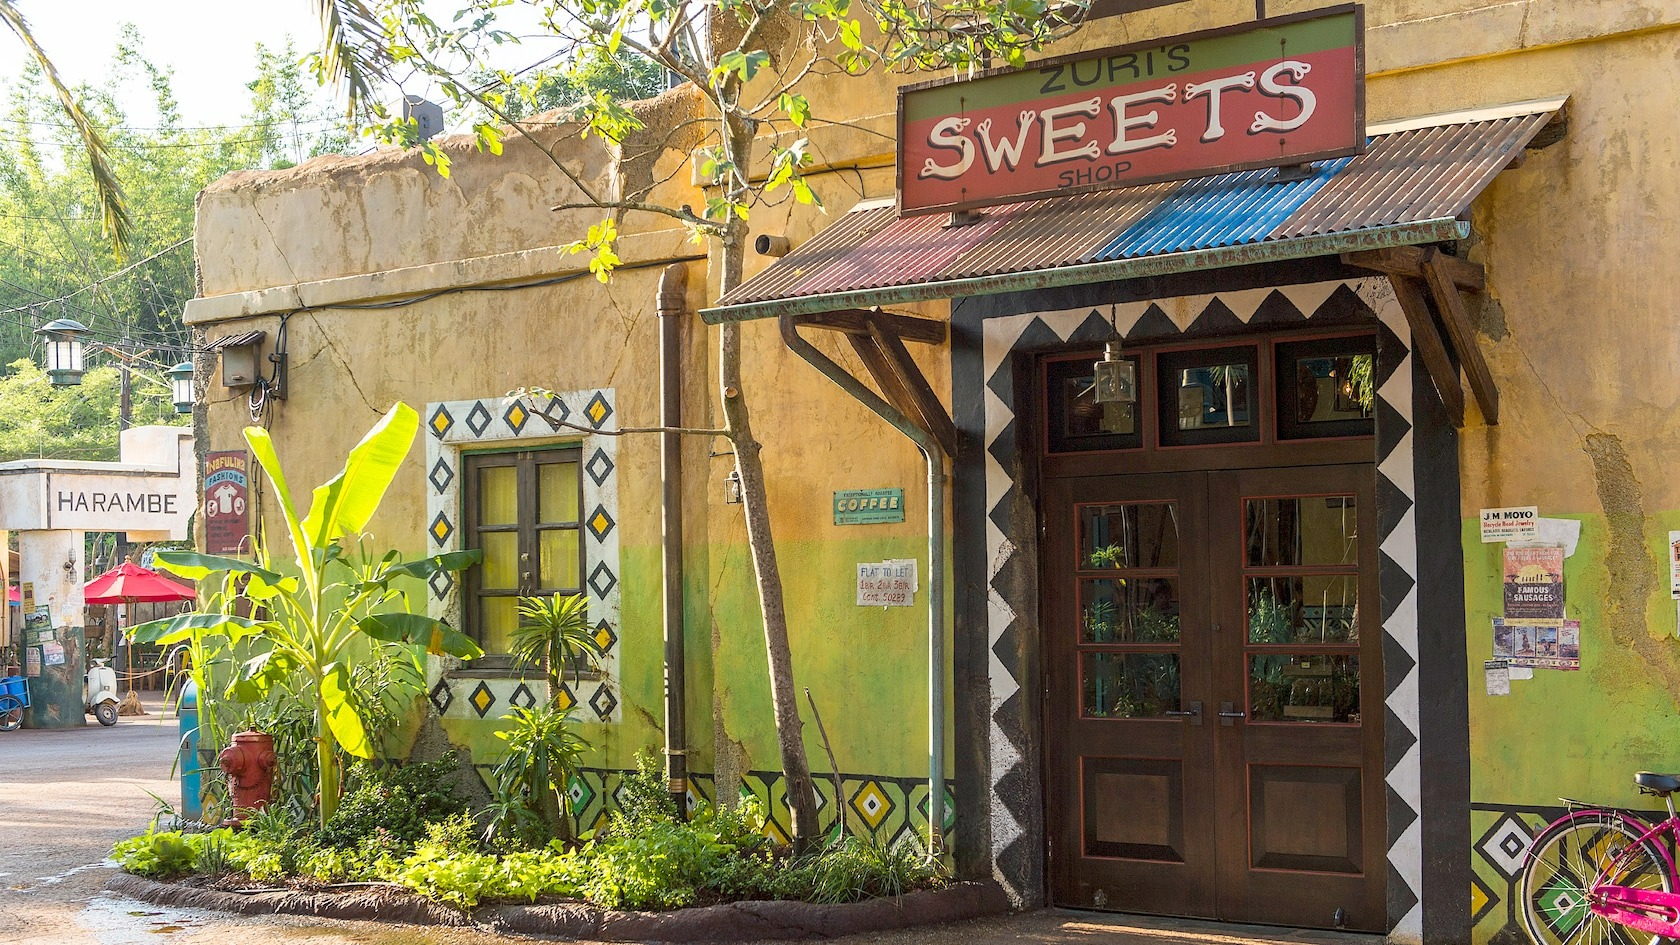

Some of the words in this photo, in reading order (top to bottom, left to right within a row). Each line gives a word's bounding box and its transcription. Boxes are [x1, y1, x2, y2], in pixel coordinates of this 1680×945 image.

[1039, 44, 1190, 94] ZURI'S
[918, 60, 1317, 180] SWEETS
[1058, 161, 1132, 189] SHOP
[209, 472, 244, 486] FASHIONS
[58, 491, 178, 515] HARAMBE
[838, 497, 899, 512] COFFEE
[1504, 511, 1533, 519] MOYO
[861, 567, 879, 578] FLAT
[883, 567, 892, 578] TO
[896, 567, 909, 578] LET
[1517, 586, 1549, 594] FAMOUS
[1513, 594, 1554, 602] SAUSAGES
